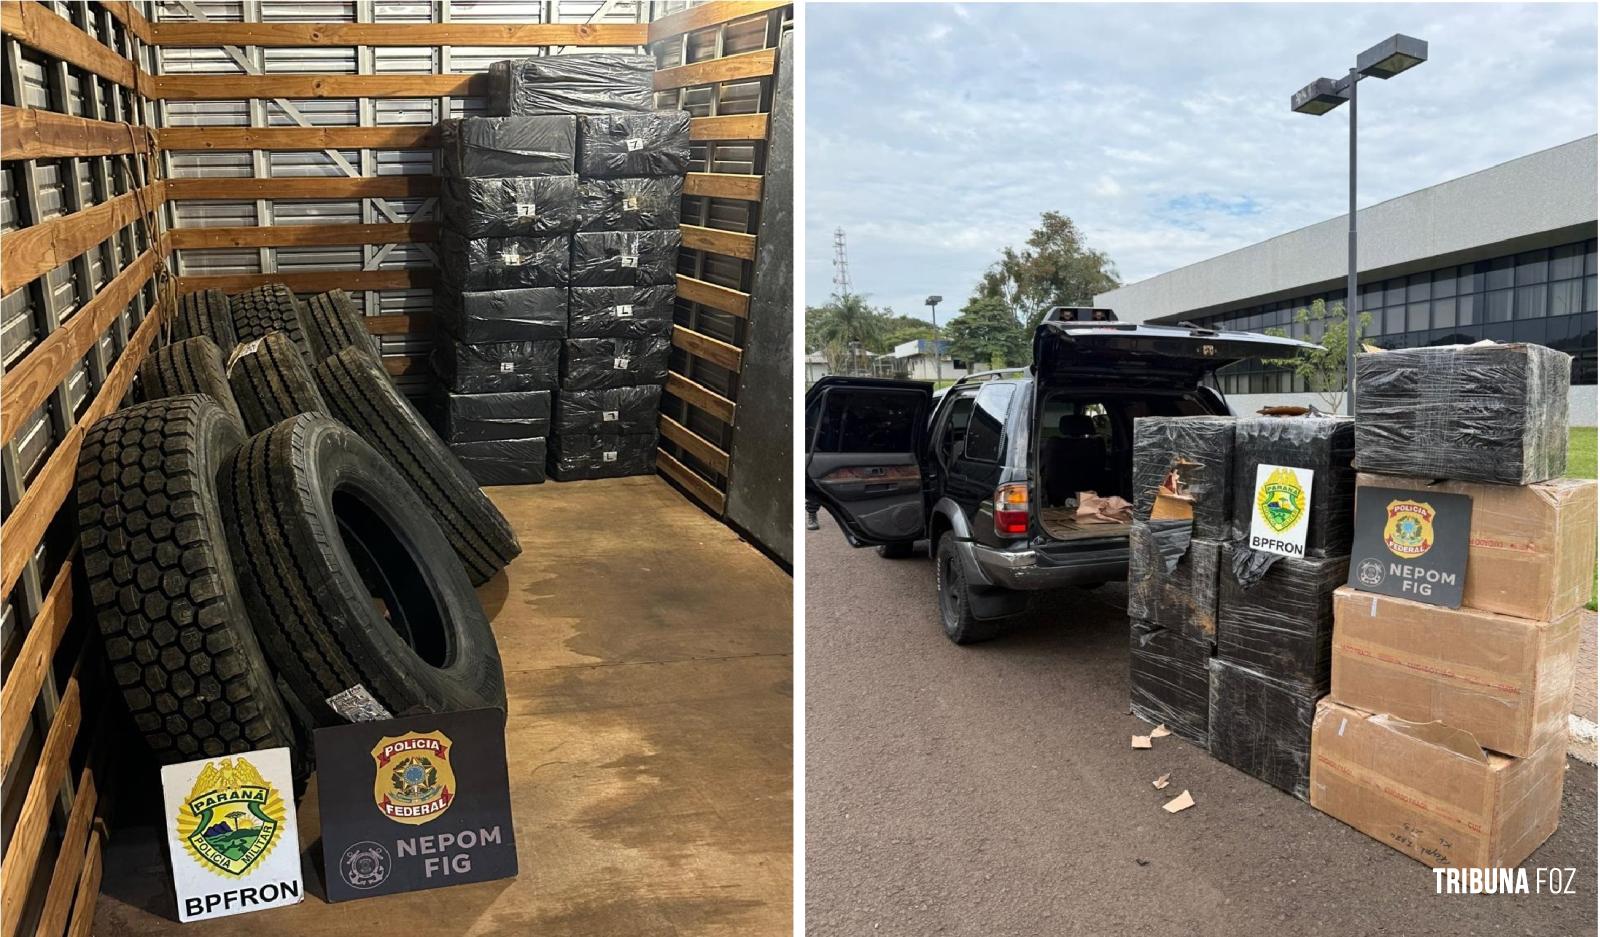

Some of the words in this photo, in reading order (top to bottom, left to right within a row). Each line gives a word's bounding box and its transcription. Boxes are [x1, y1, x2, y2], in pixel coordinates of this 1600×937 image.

[1252, 536, 1303, 555] BPFRON
[1389, 540, 1425, 553] FEDERAL
[1389, 563, 1456, 585] NEPOM
[1402, 580, 1432, 596] FIG
[194, 790, 264, 812] PARANÁ
[385, 798, 446, 817] FEDERAL
[241, 825, 273, 863] MILITAR
[396, 825, 502, 858] NEPOM
[424, 853, 472, 878] FIG
[185, 880, 299, 917] BPFRON
